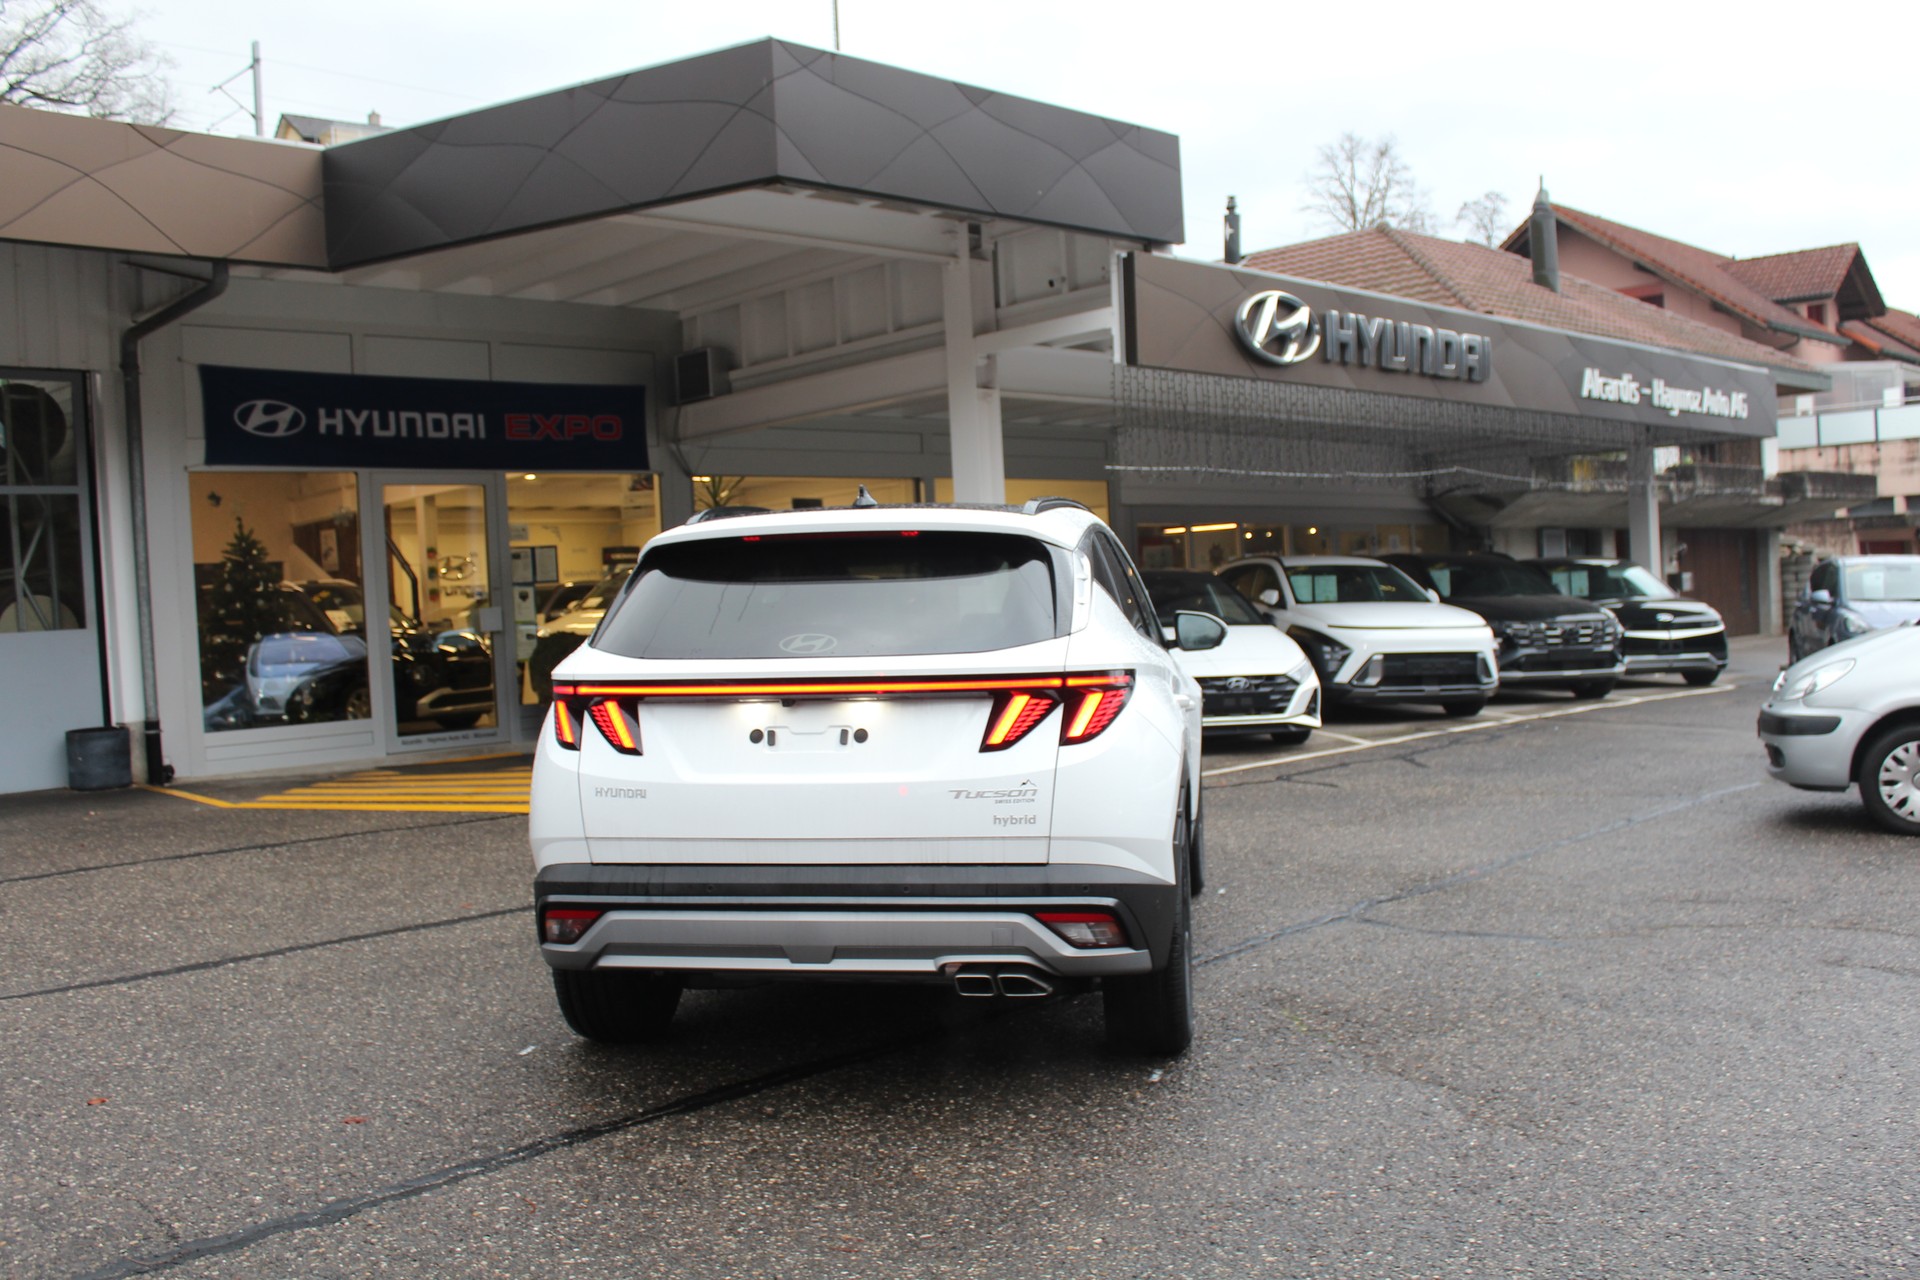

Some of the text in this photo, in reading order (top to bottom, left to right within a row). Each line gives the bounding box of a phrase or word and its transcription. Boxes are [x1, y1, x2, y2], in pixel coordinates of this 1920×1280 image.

[1325, 309, 1492, 382] HYUNDAI
[318, 408, 622, 440] HYUNDAI EXPO
[595, 787, 647, 799] HYUNDAI
[993, 815, 1036, 827] hybrid
